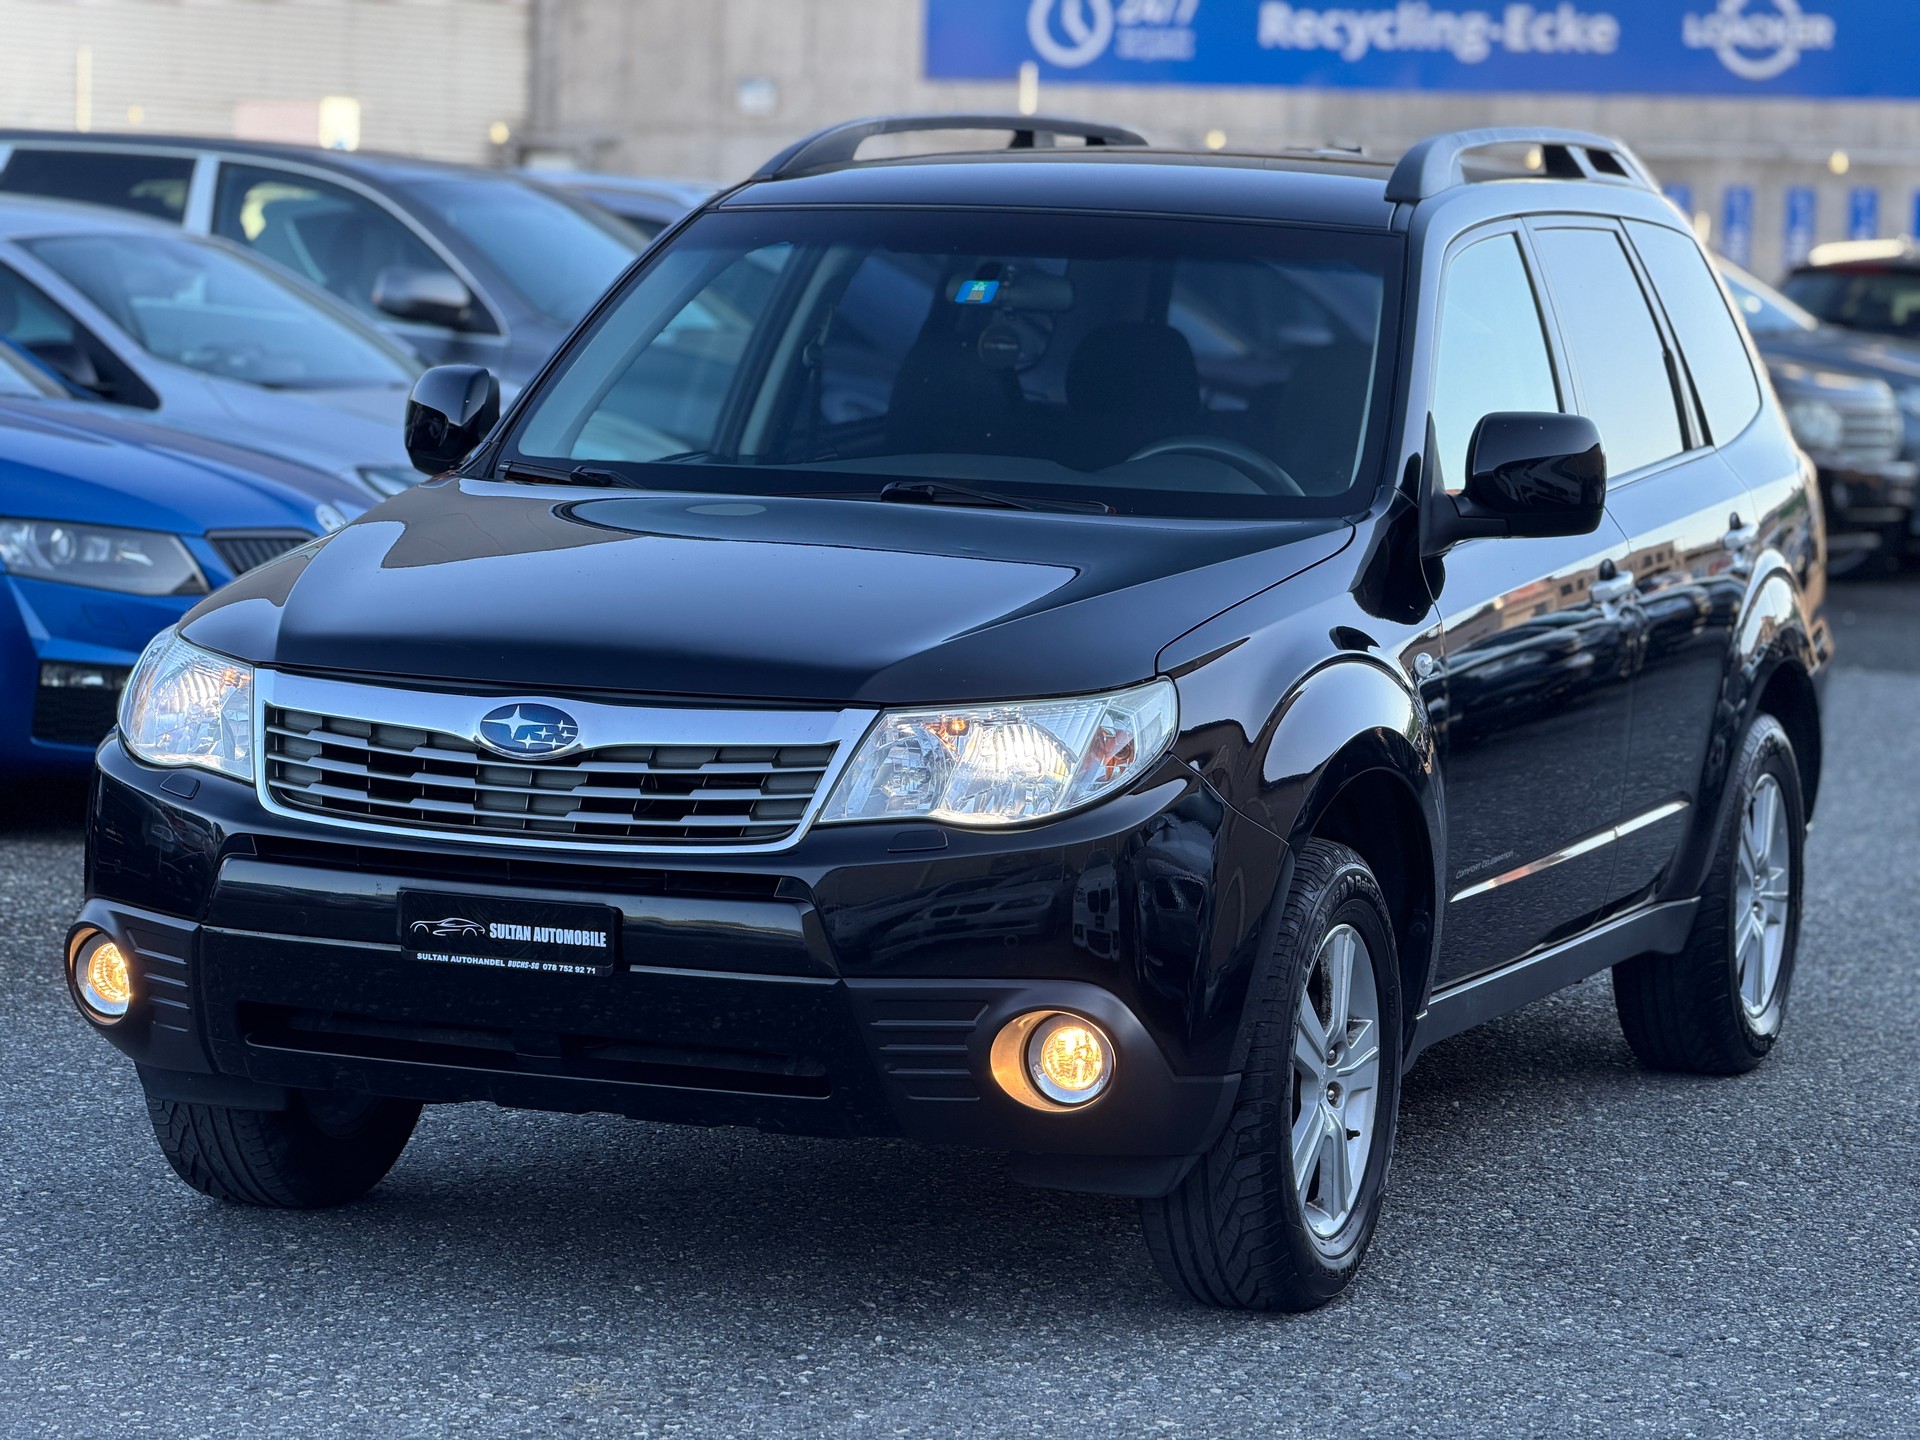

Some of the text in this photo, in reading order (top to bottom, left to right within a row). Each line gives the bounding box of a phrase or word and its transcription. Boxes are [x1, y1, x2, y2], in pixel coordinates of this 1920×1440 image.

[1257, 1, 1620, 64] Recycling-Ecke
[489, 922, 607, 948] SULTAN AUTOMOBILE
[416, 952, 596, 975] SULTAN AUTOHANDEL BUCHS-SG 078 752 92 71
